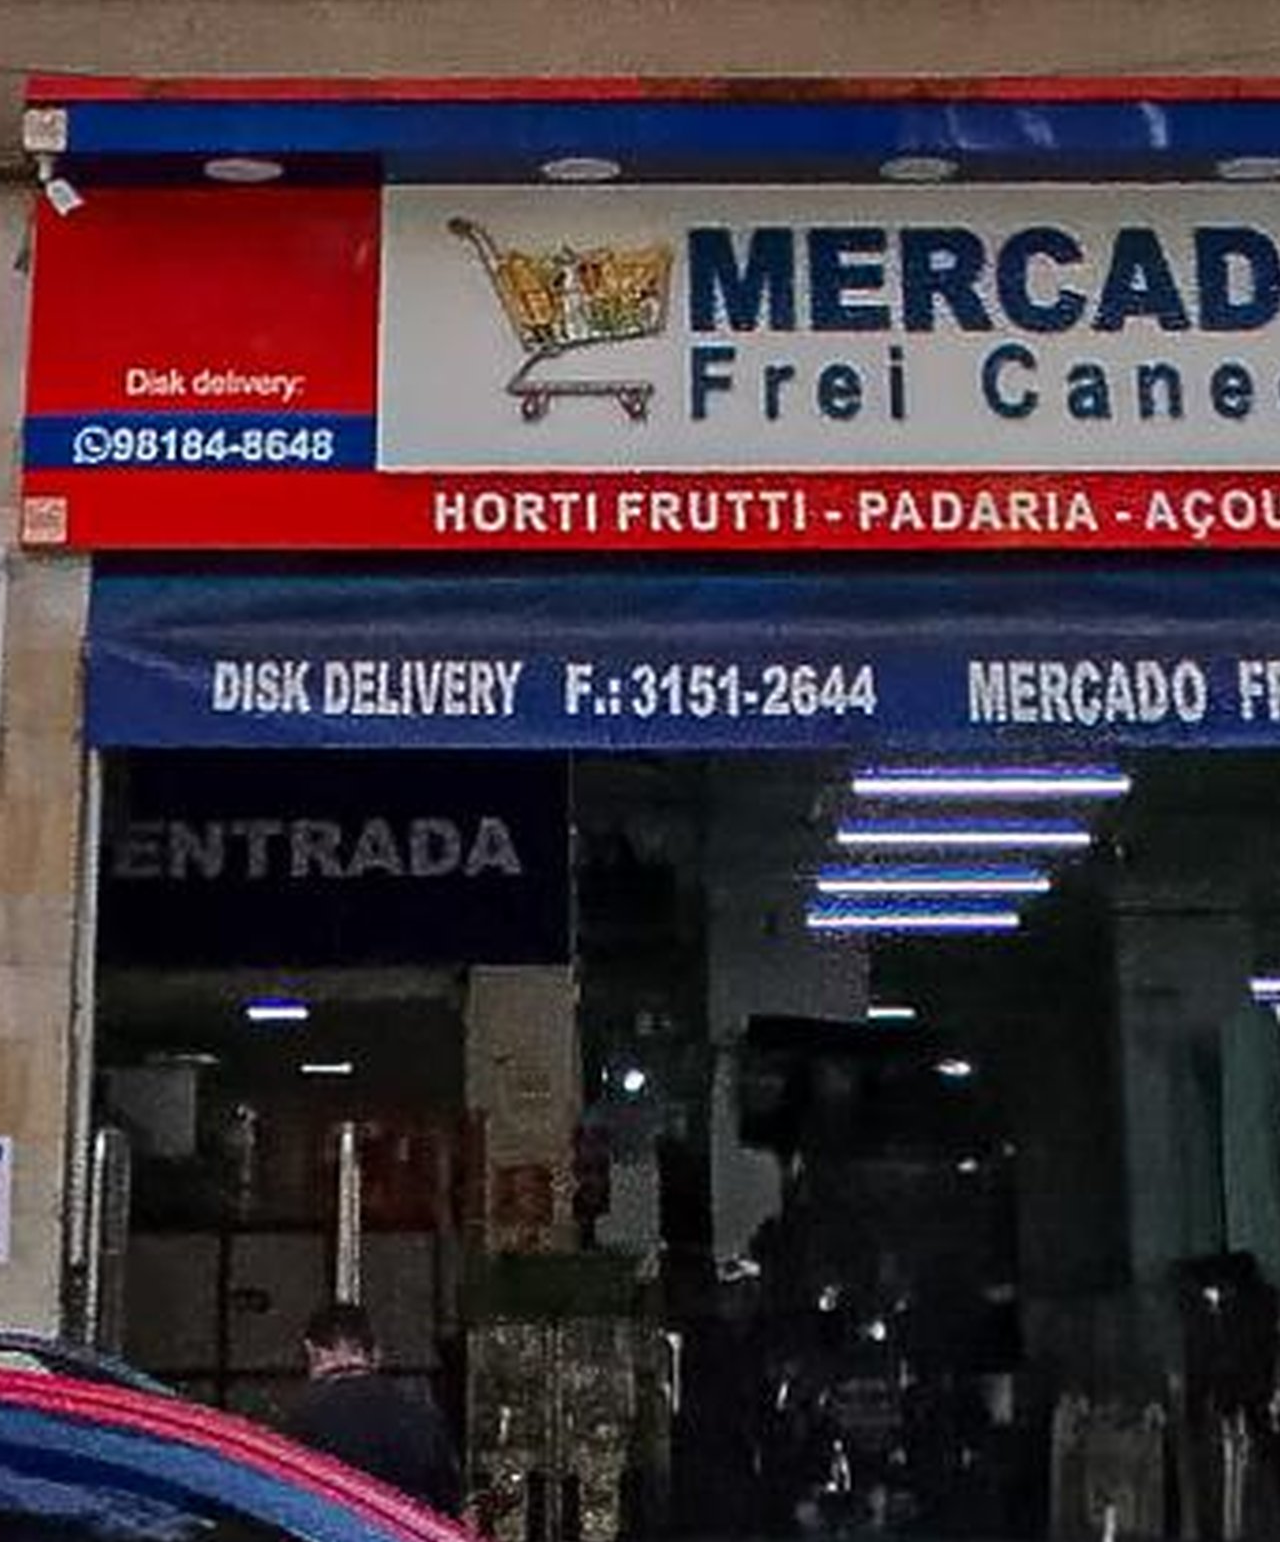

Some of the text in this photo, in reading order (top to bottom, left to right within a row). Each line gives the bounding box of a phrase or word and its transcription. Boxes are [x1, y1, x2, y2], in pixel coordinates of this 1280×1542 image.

[126, 368, 305, 402] Disk delivery:
[690, 344, 907, 422] Frei
[112, 427, 334, 462] 98184-8648
[434, 491, 598, 533] HORTI
[617, 490, 807, 532] FRUTTI
[858, 490, 1100, 532] PADARIA
[212, 660, 311, 713] DISK
[323, 660, 523, 716] DELIVERY
[632, 664, 878, 718] 3151-2644
[968, 659, 1208, 725] MERCADO
[114, 816, 524, 879] ENTRADA
